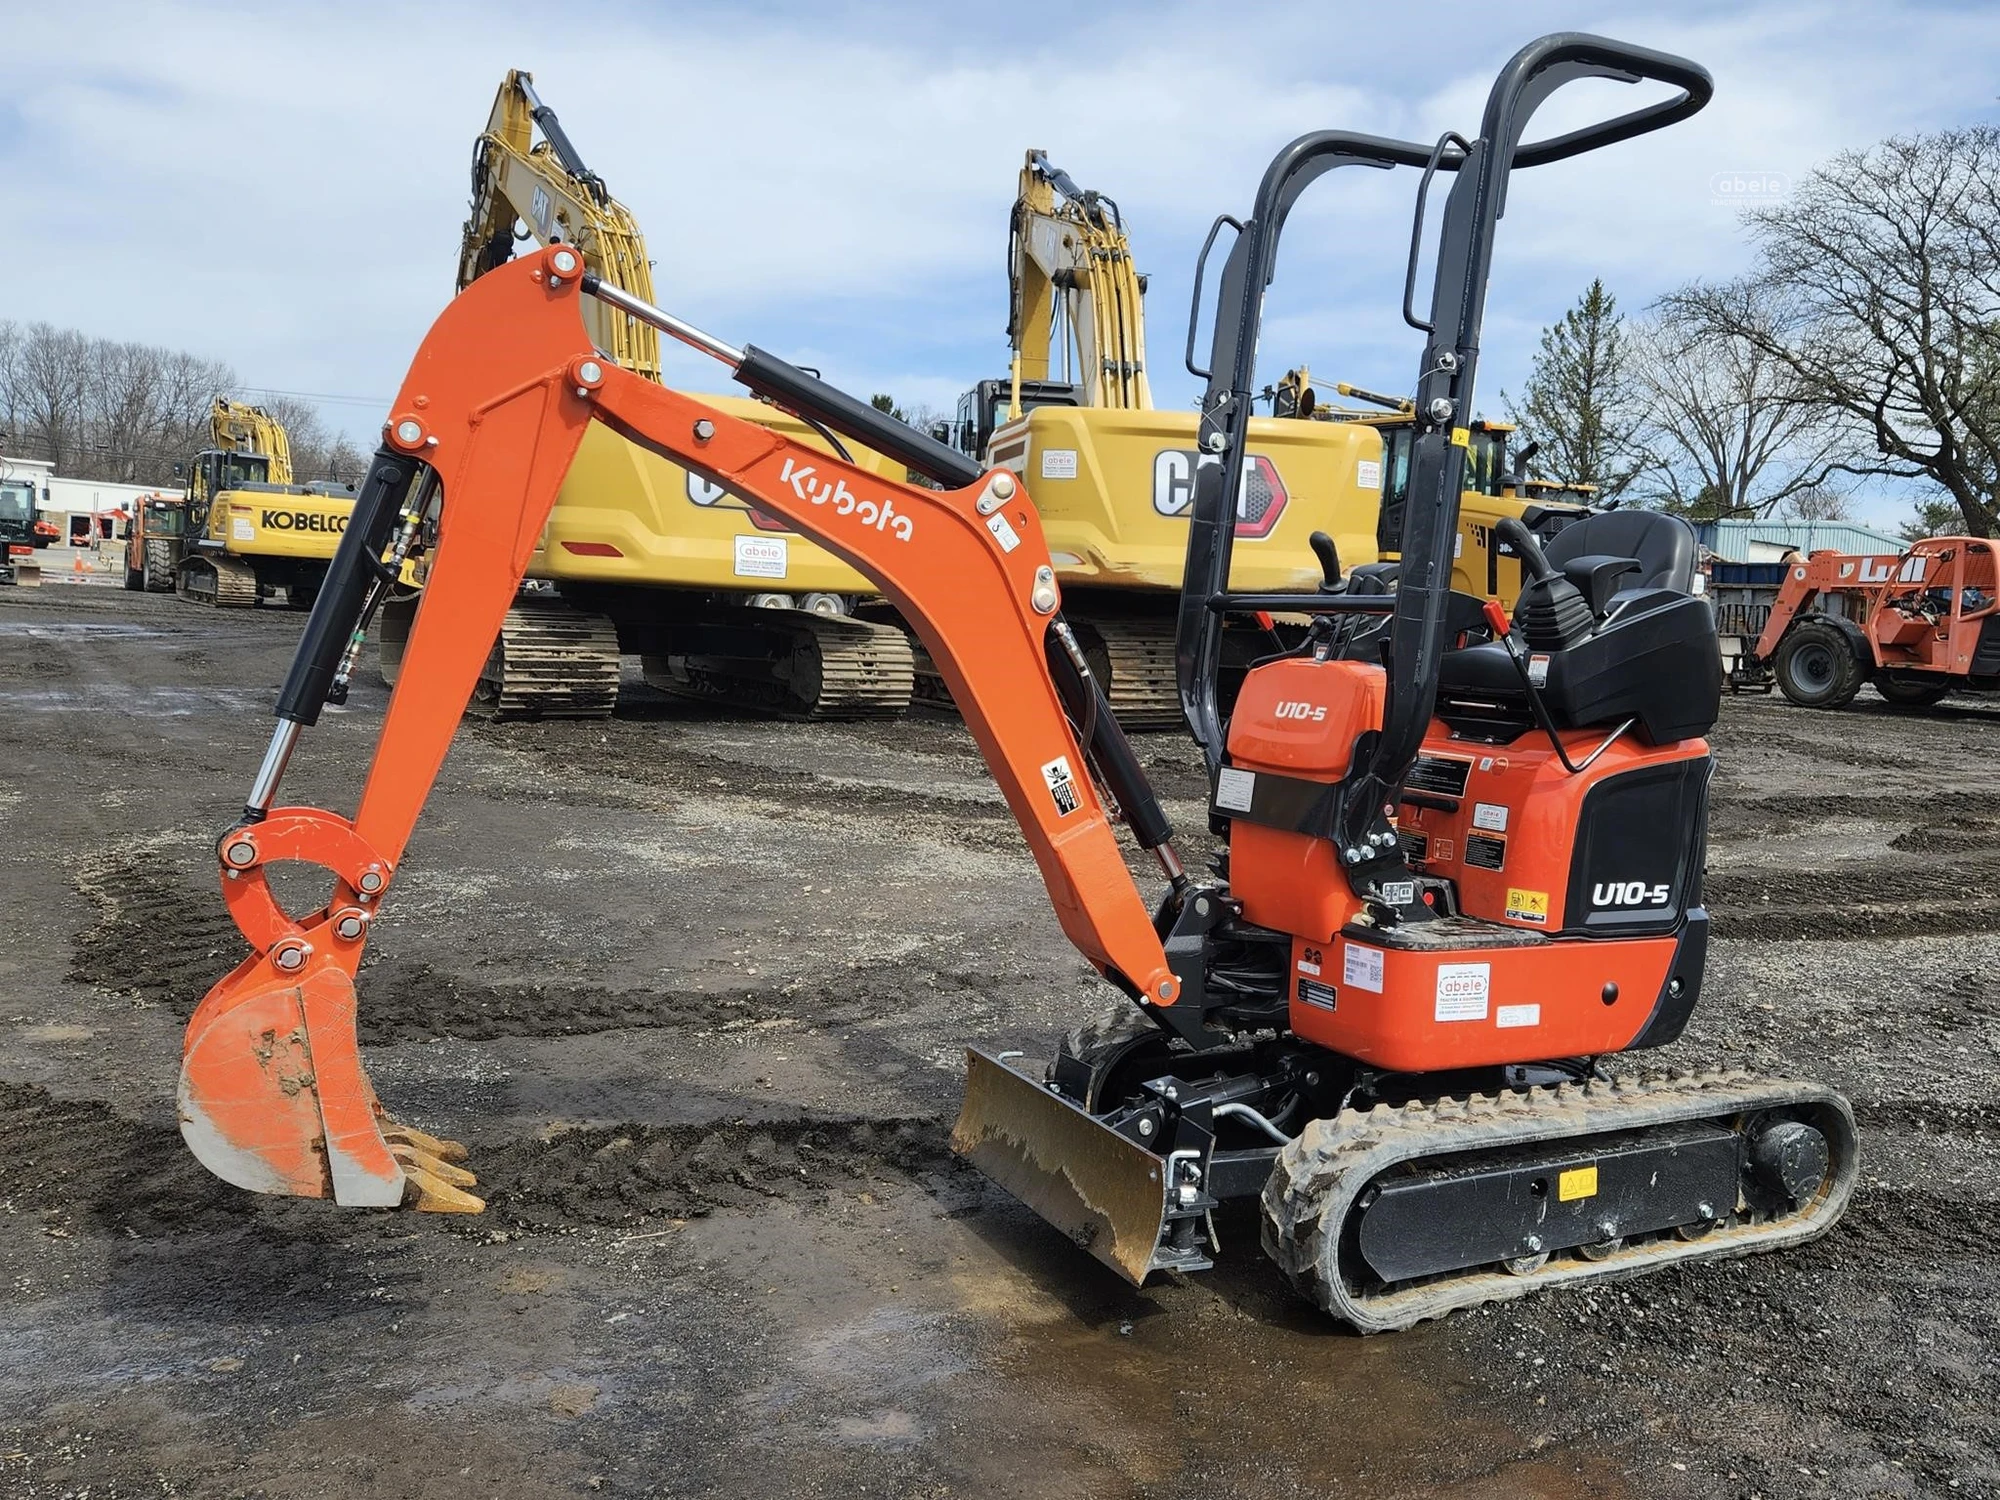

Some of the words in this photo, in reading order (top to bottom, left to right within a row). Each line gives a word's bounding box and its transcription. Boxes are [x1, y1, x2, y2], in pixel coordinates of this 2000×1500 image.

[532, 184, 549, 226] CAT
[1155, 450, 1256, 519] CT
[780, 457, 913, 542] Kubota
[745, 547, 779, 557] abele
[1275, 701, 1328, 721] U10-5
[1592, 881, 1670, 906] U10-5
[1445, 980, 1482, 992] abele
